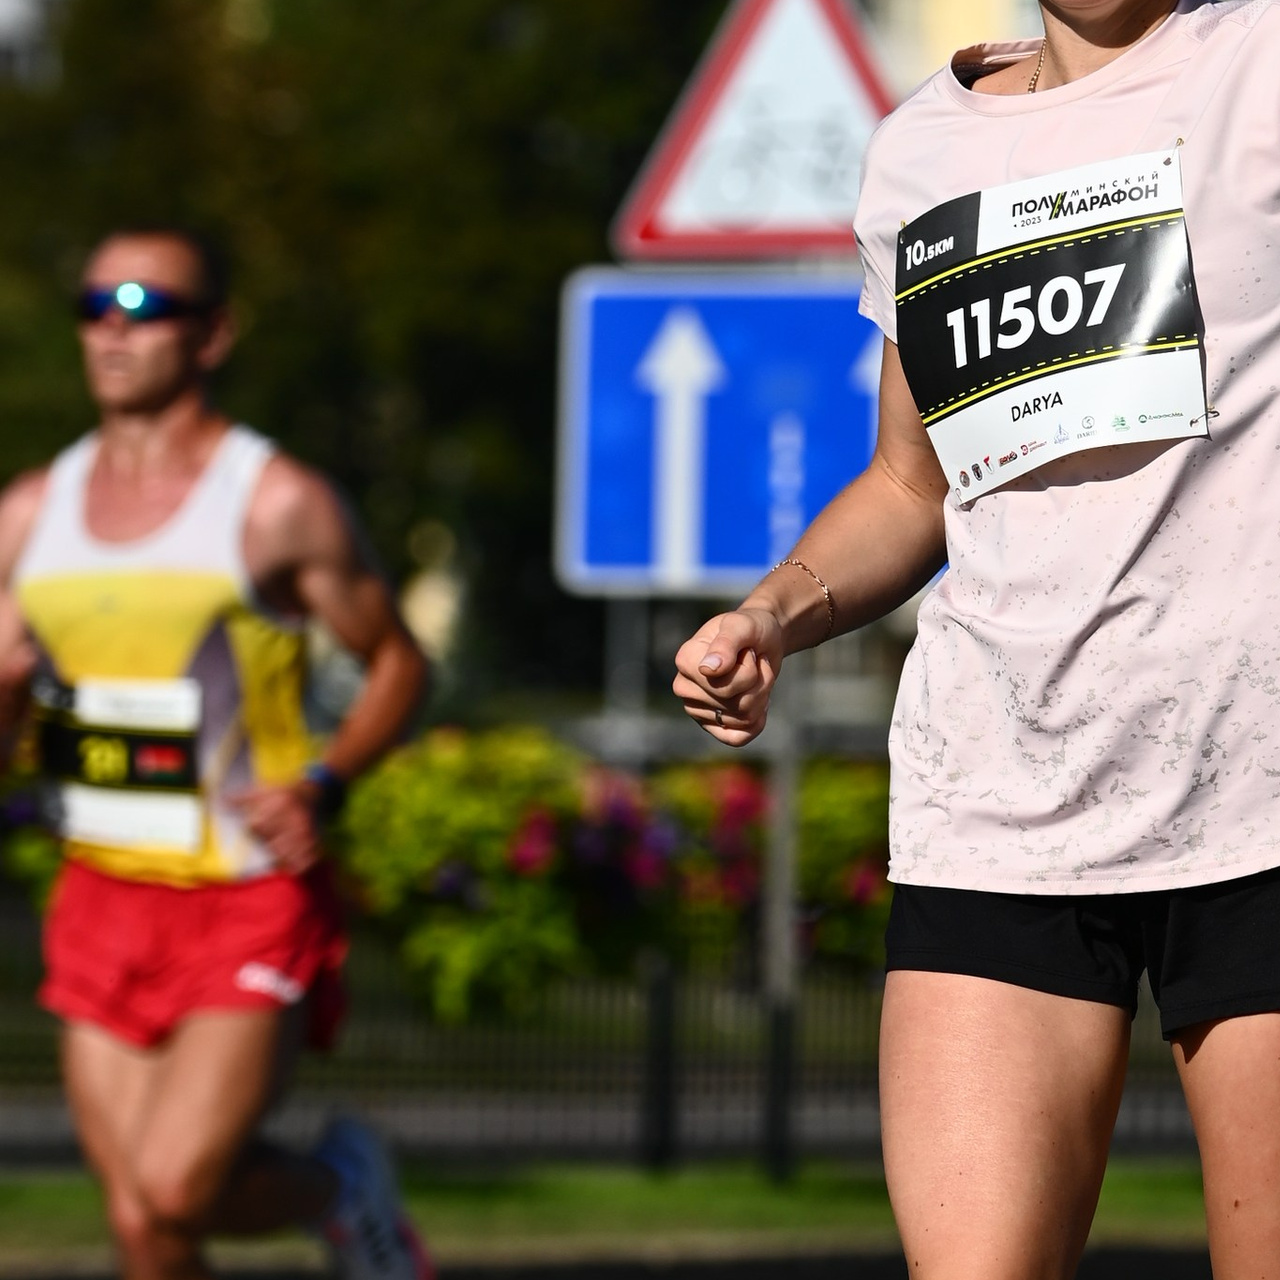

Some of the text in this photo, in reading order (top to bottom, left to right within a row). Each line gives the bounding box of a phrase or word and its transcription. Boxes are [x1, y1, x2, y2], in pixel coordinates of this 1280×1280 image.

[1070, 170, 1159, 197] МИНСКИЙ
[1020, 215, 1042, 228] 2023
[946, 263, 1127, 370] 11507
[1010, 391, 1064, 423] DARYA
